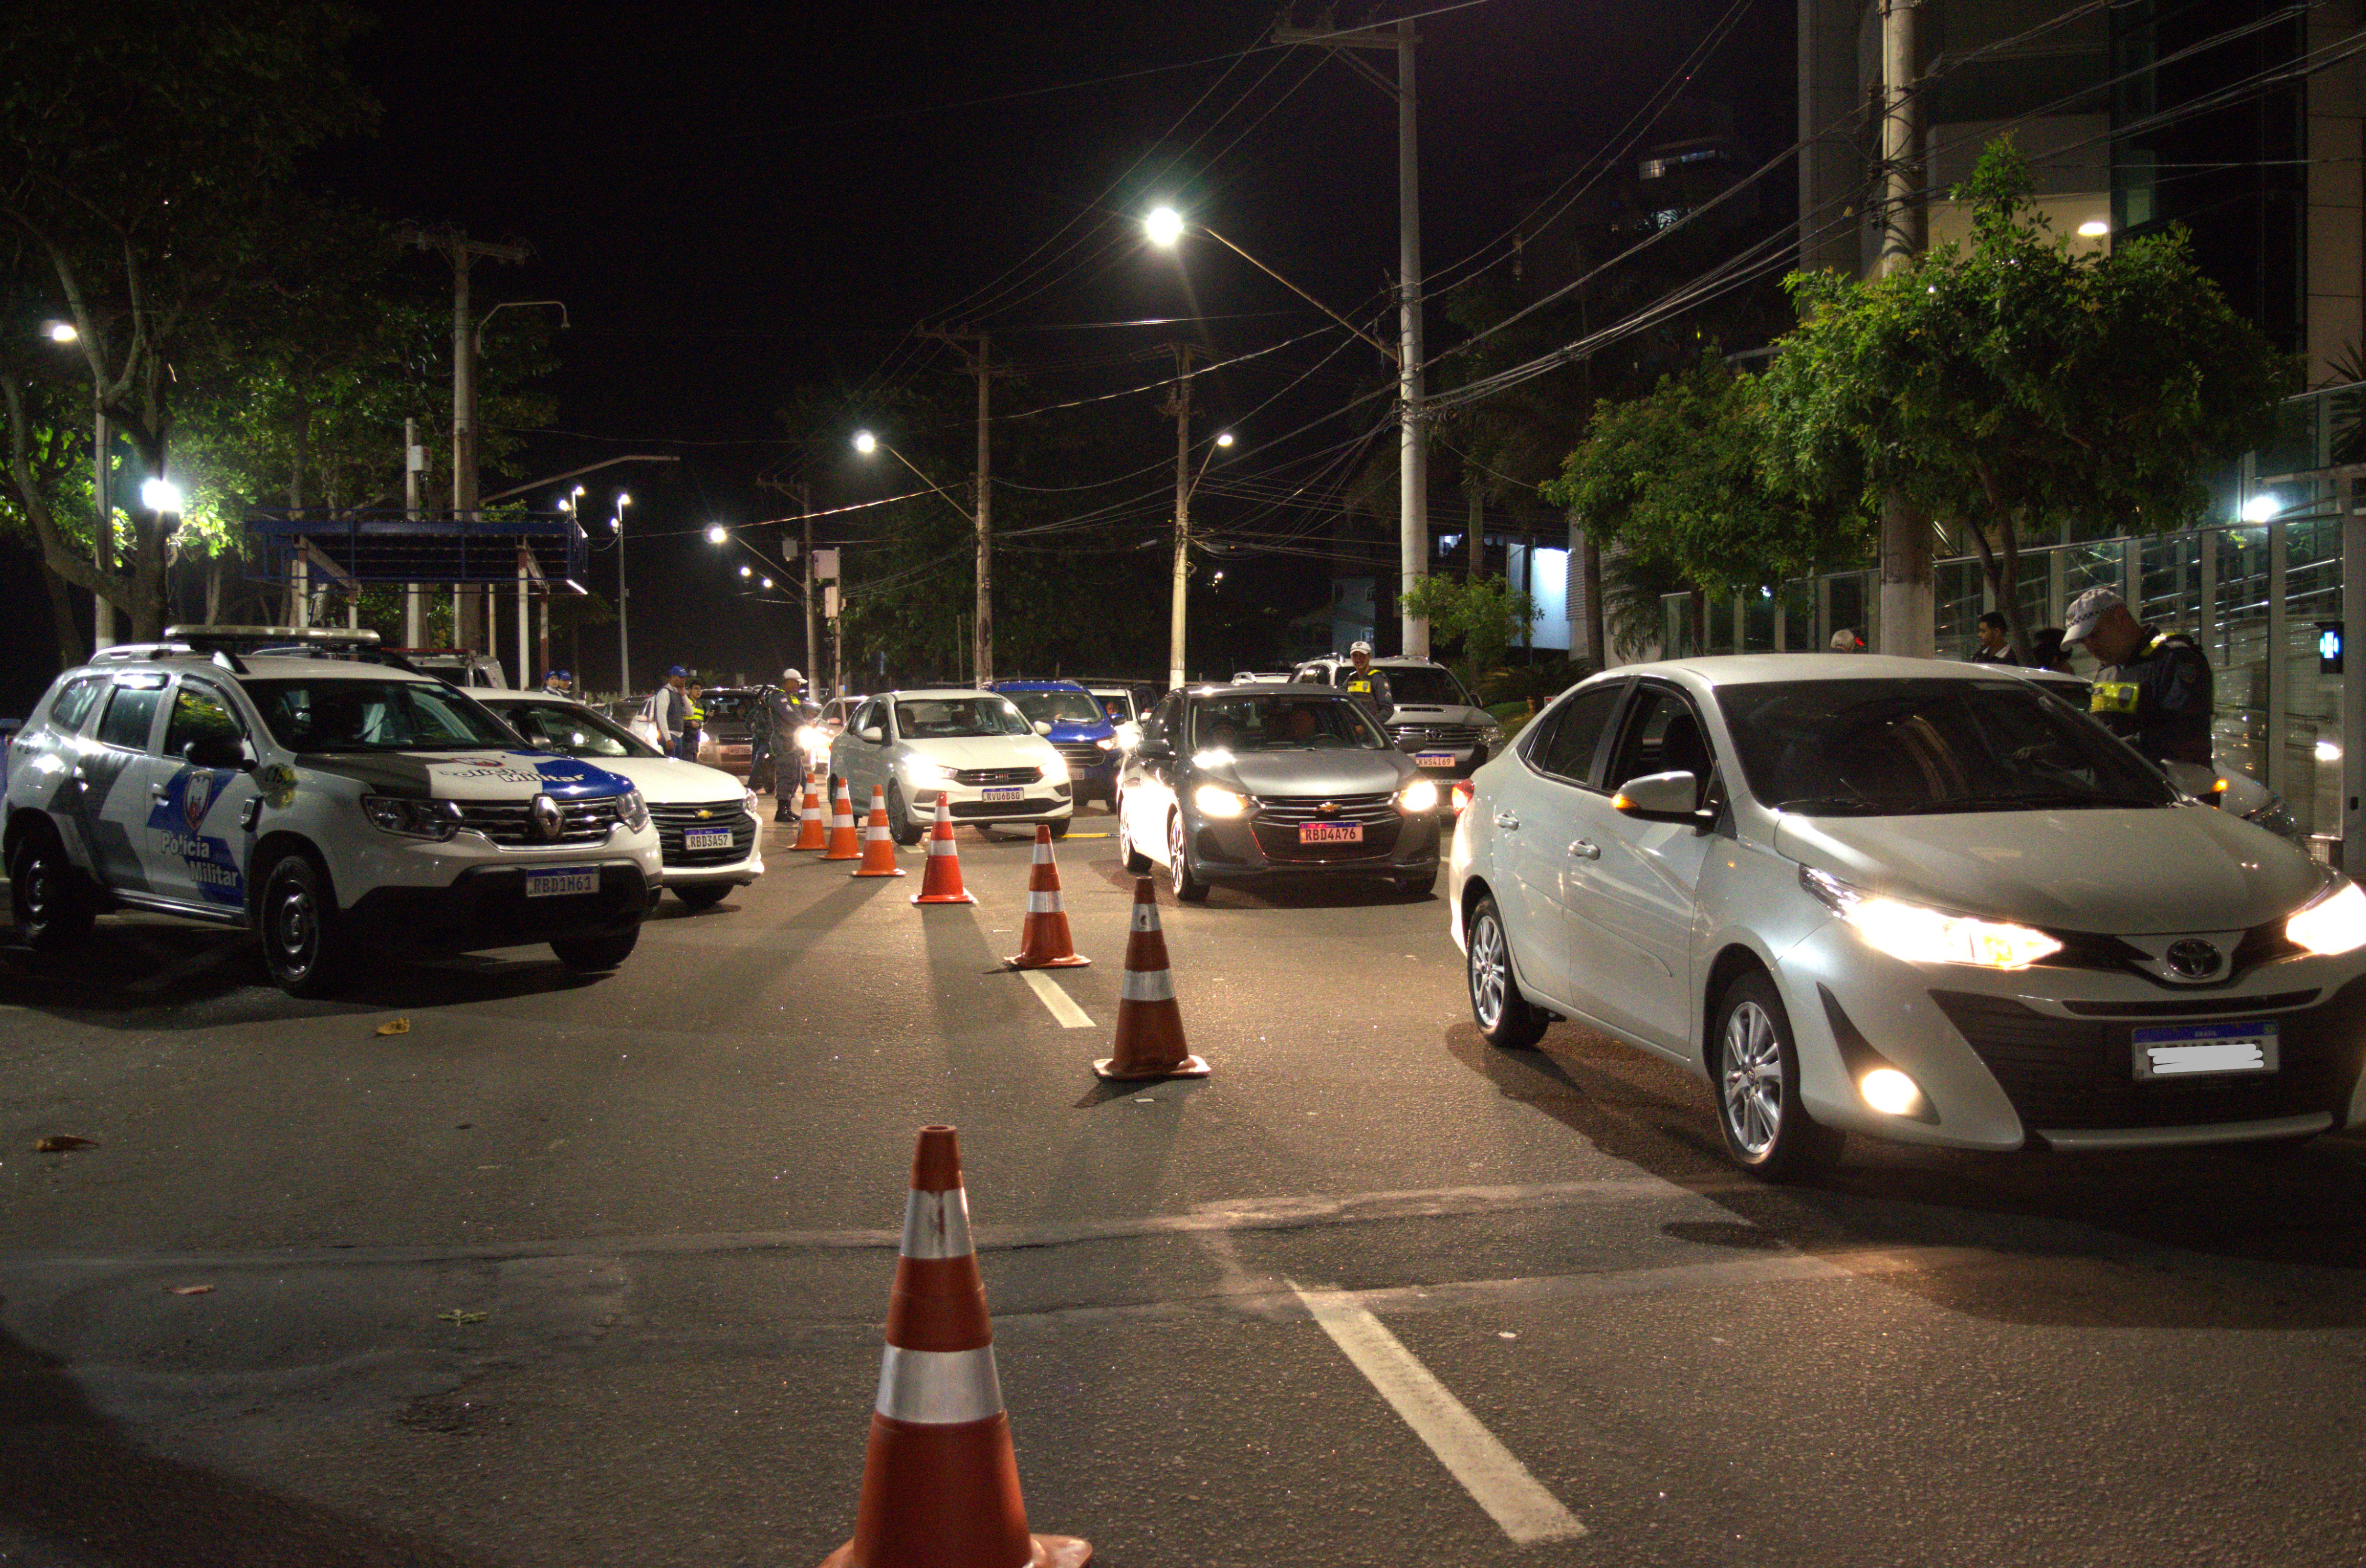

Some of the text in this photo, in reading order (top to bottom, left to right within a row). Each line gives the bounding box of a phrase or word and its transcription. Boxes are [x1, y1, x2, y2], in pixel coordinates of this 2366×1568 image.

[499, 773, 584, 782] Militar
[986, 792, 1020, 801] RVU6B80
[690, 834, 728, 848] RBD3A57
[1305, 828, 1356, 841] RBD4A76
[189, 860, 239, 887] Militar
[534, 875, 592, 893] RBD1M61
